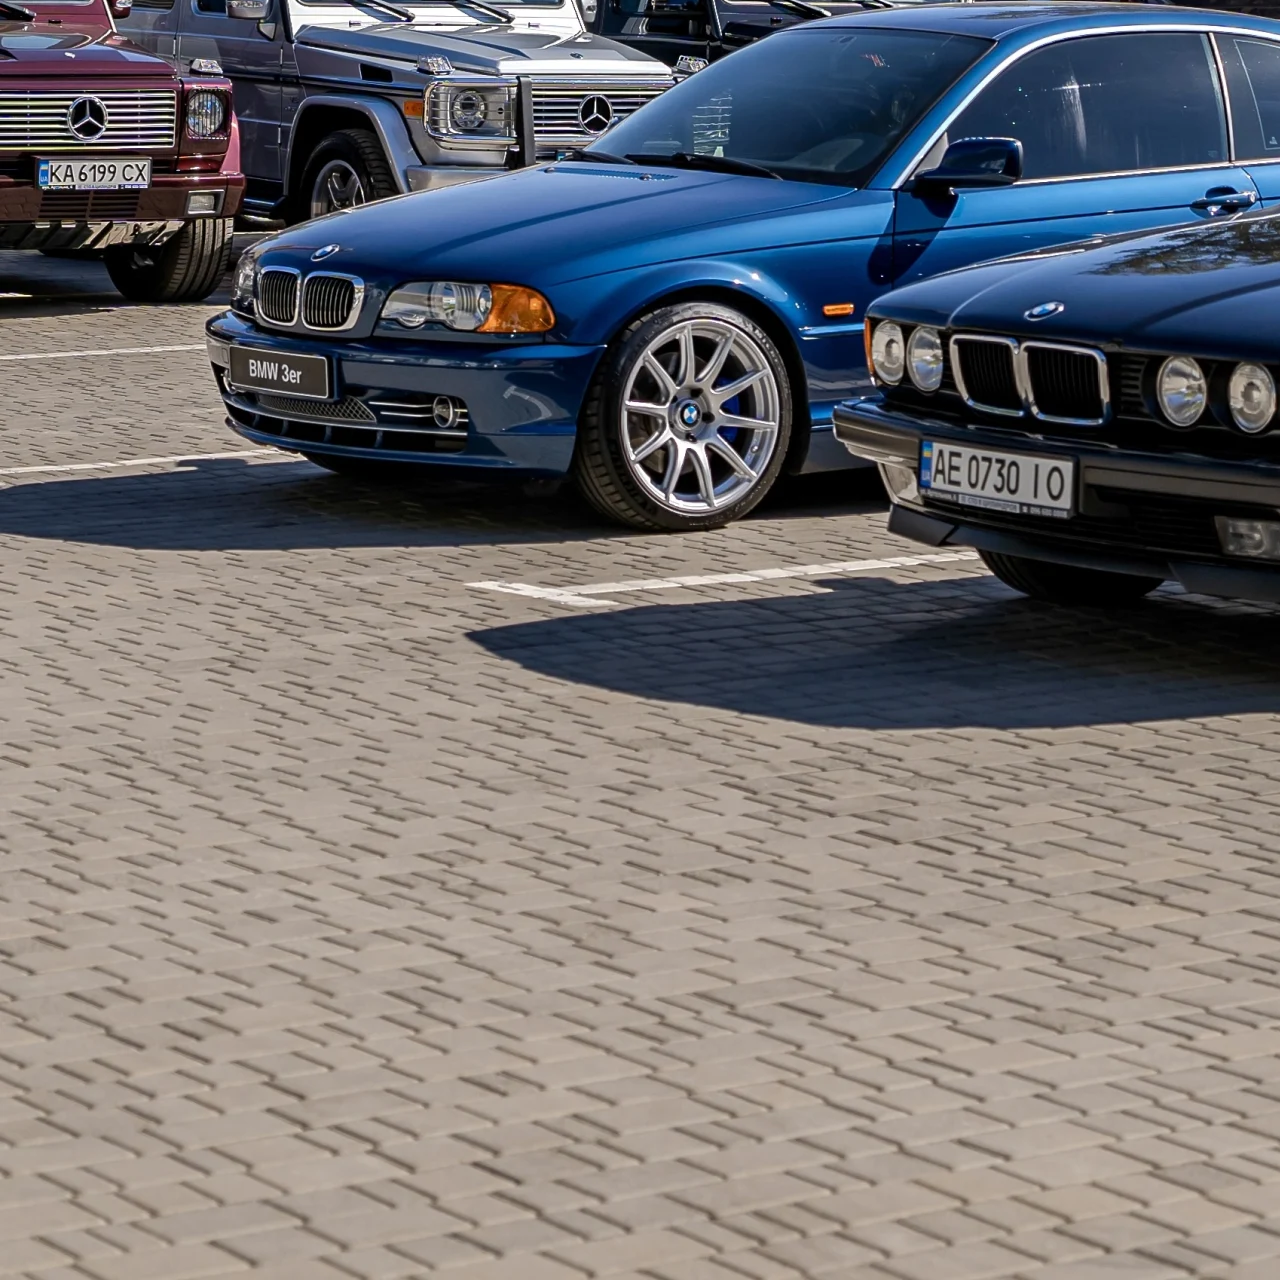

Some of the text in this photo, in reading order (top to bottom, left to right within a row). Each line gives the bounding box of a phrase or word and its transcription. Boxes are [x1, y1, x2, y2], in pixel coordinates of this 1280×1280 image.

[50, 164, 75, 183] KA
[78, 164, 117, 182] 6199
[122, 163, 147, 182] CX
[248, 359, 302, 384] BMW 3er
[933, 448, 962, 487] AE
[967, 454, 1020, 495] 0730
